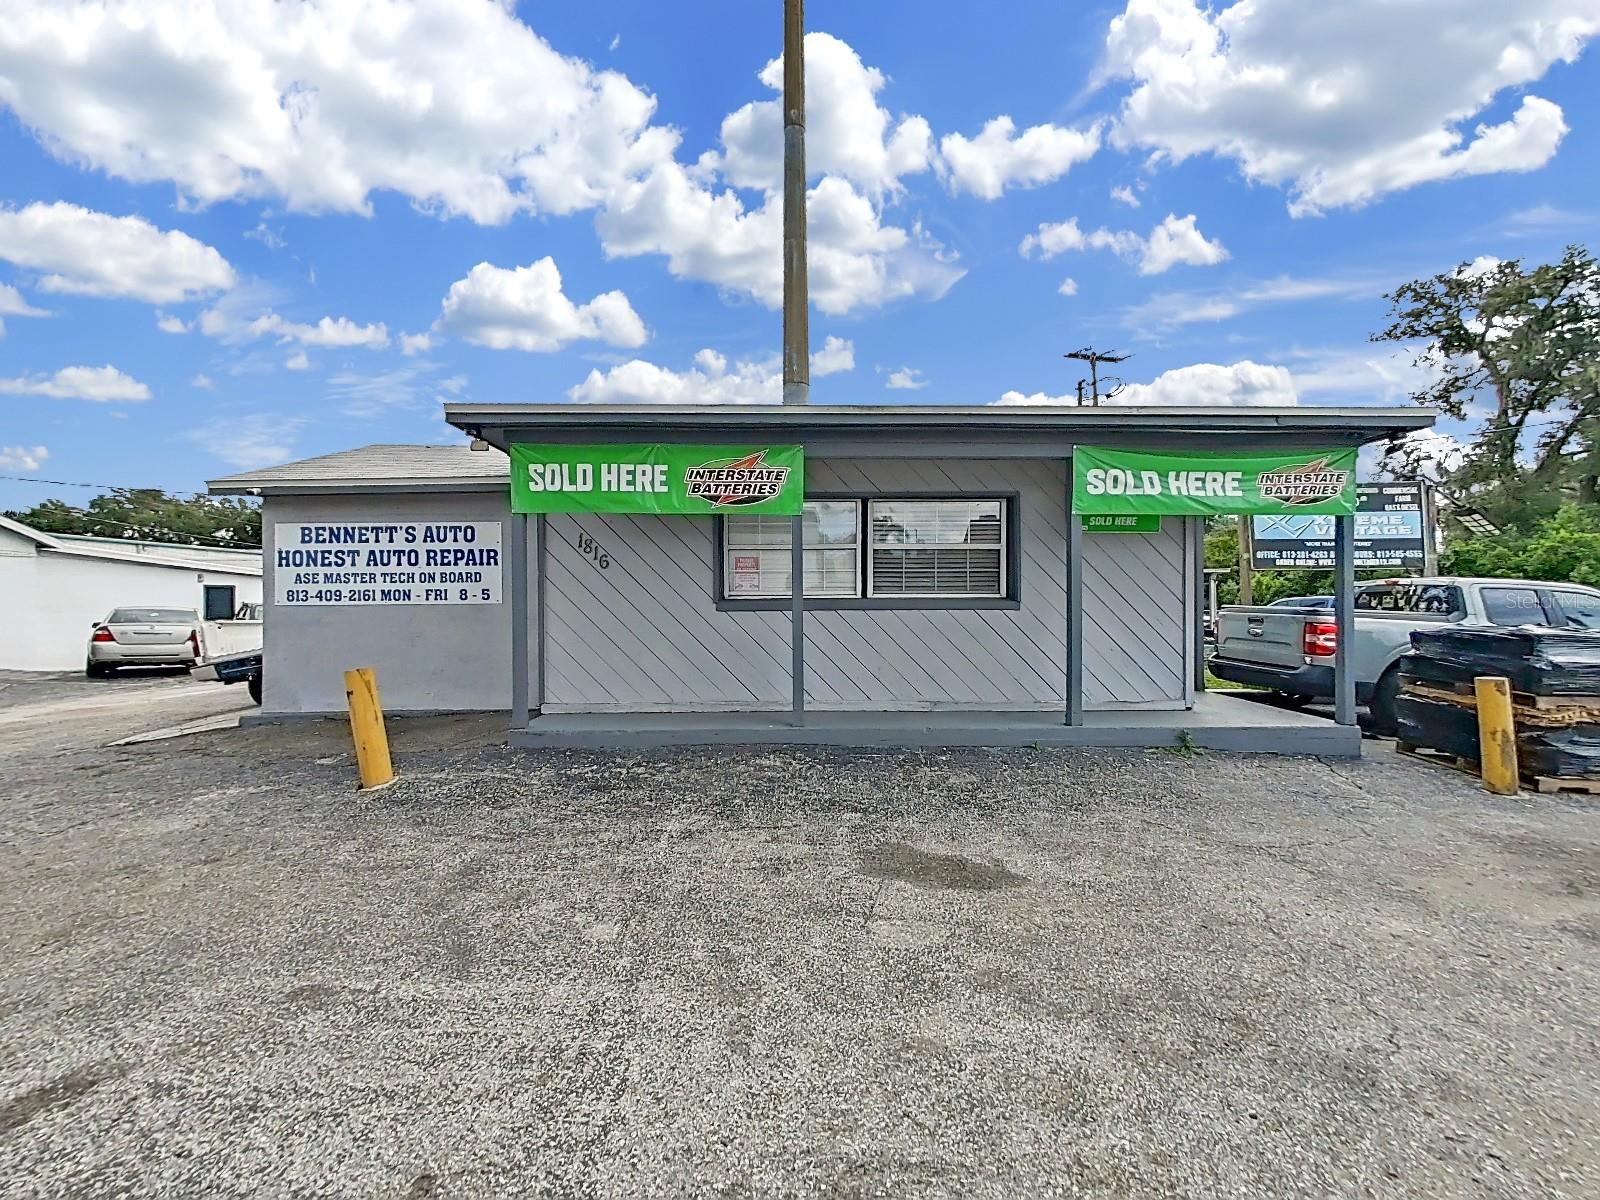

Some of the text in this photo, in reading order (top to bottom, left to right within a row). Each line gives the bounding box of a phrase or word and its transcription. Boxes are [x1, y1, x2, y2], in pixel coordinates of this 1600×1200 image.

[528, 463, 669, 492] SOLD HERE
[688, 469, 785, 481] INTERSTATE
[1260, 473, 1345, 484] INTERSTATE
[1086, 468, 1243, 496] SOLD HERE
[691, 482, 778, 495] BATTERIES
[1264, 485, 1339, 496] BATTERIES
[1089, 516, 1138, 526] SOLD HERE
[300, 525, 476, 544] BENNETT'S AUTO
[1314, 526, 1414, 536] VTAGE
[578, 532, 610, 569] 1816
[1256, 550, 1280, 559] OFFICE:
[277, 549, 499, 567] HONEST AUTO REPAIR
[294, 572, 482, 584] ASE MASTER TECH ON BOARD
[286, 590, 376, 602] 813-409-2161
[380, 589, 411, 601] MON
[425, 589, 448, 601] FRI
[459, 589, 468, 601] 8
[481, 589, 490, 600] 5
